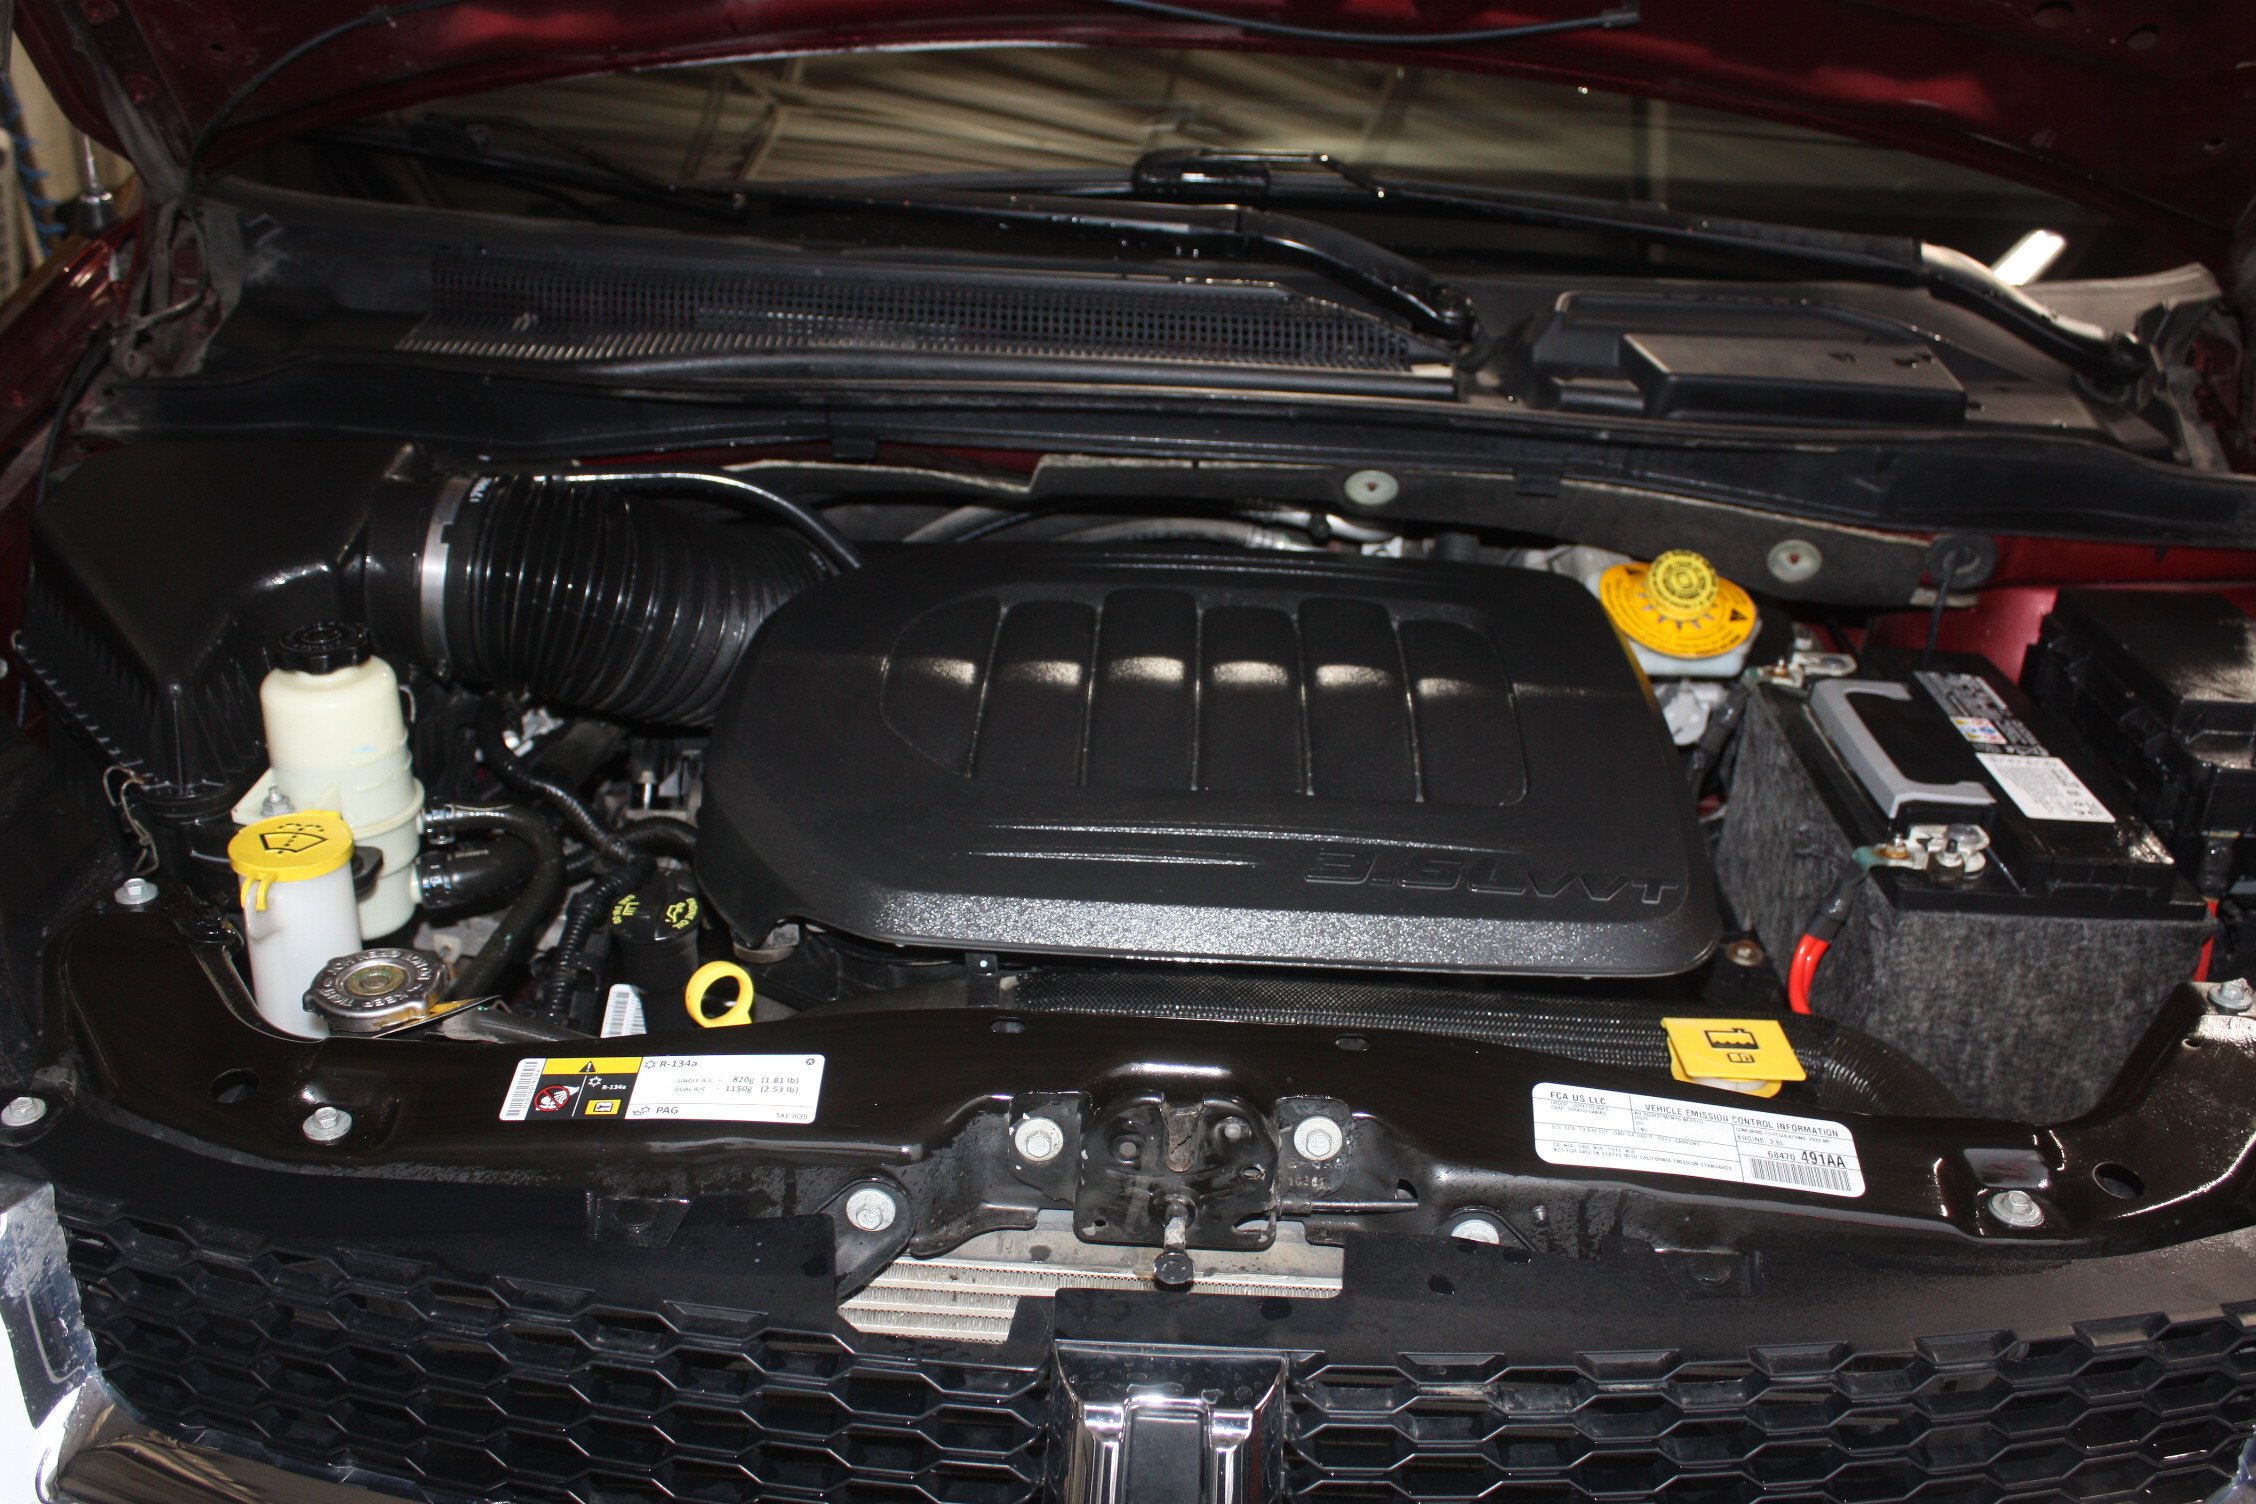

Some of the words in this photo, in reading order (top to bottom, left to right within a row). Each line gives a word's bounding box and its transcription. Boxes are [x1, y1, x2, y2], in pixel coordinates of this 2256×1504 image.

[1303, 847, 1527, 896] 3.6L
[1528, 870, 1680, 906] VVT
[685, 897, 698, 920] ENGINE
[672, 919, 690, 929] OIL
[319, 988, 354, 1007] TIGHT
[362, 993, 409, 1008] KEEP
[786, 1086, 799, 1094] lb)
[1550, 1091, 1568, 1100] FCA
[1589, 1096, 1606, 1104] LLC
[1645, 1104, 1683, 1115] VEHICLE
[1686, 1110, 1729, 1122] EMISSION
[1732, 1116, 1773, 1128] CONTROL
[1777, 1122, 1839, 1137] INFORMATION
[1768, 1150, 1796, 1162] 68470
[1801, 1150, 1846, 1168] 491AA
